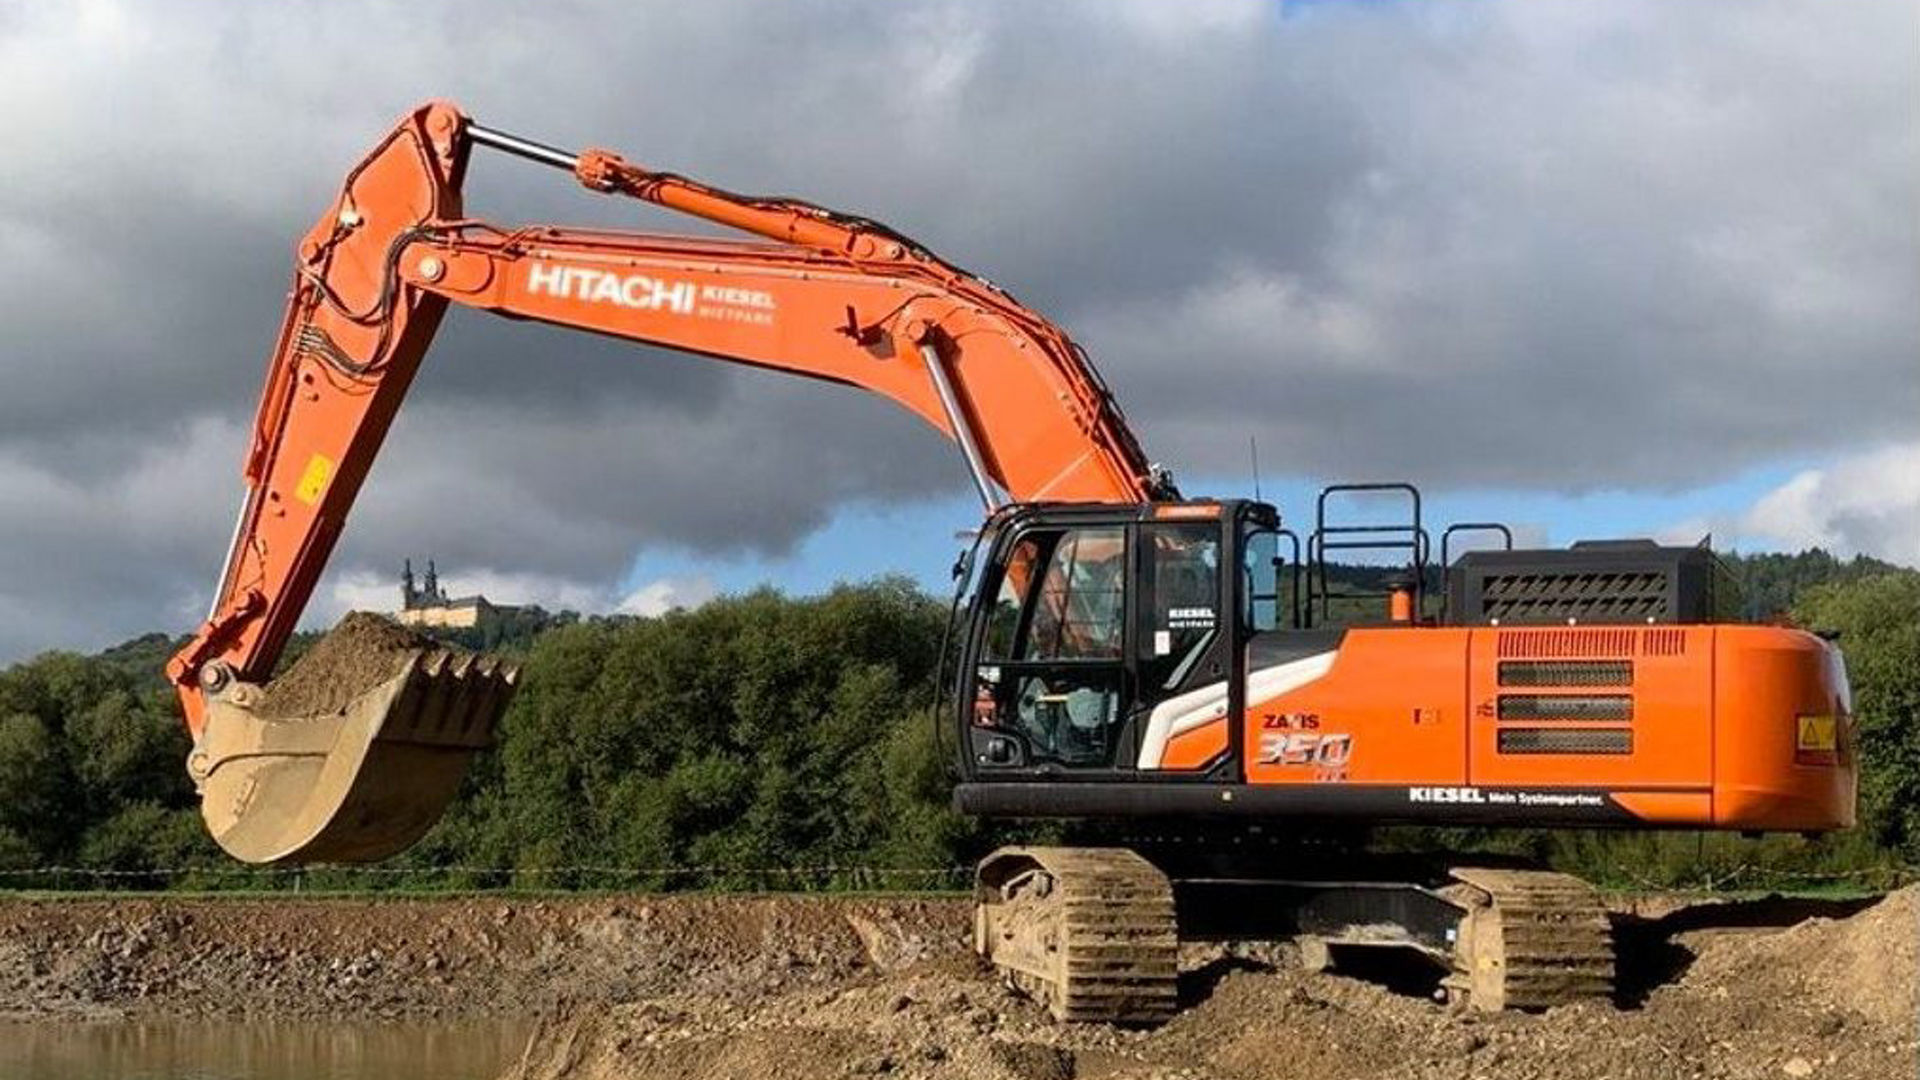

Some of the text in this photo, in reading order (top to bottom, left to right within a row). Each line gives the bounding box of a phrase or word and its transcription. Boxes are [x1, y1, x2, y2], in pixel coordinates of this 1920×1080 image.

[528, 263, 696, 315] HITACHI
[702, 285, 776, 309] KIESEL
[1168, 607, 1216, 619] KIESEL
[1258, 733, 1352, 766] 350
[1409, 787, 1485, 803] KIESEL
[1488, 792, 1516, 803] Mein
